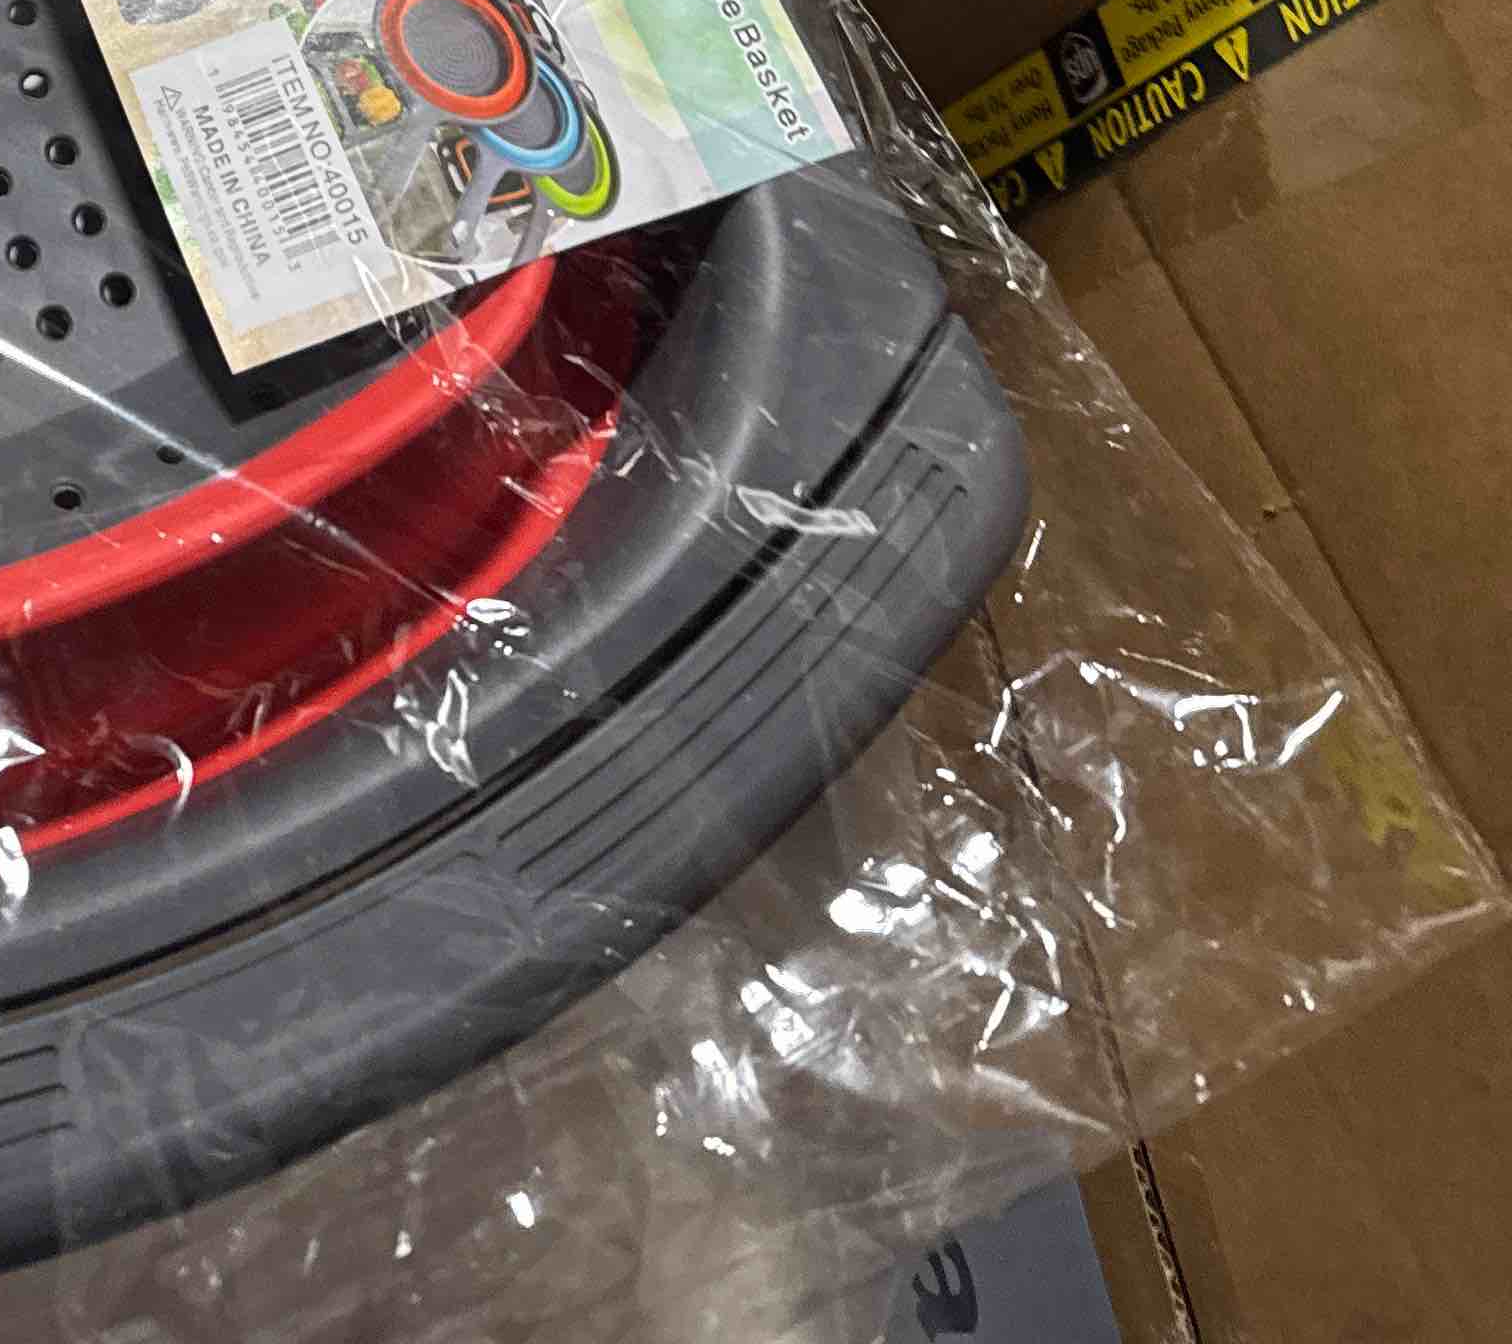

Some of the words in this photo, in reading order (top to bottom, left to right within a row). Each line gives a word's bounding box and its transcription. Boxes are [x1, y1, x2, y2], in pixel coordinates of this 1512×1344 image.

[1119, 14, 1185, 63] Package
[271, 53, 315, 118] ITEM
[733, 21, 812, 141] Basket
[1087, 61, 1207, 159] CAUTION
[193, 103, 232, 169] MADE
[219, 170, 244, 196] IN
[231, 196, 272, 268] CHINA
